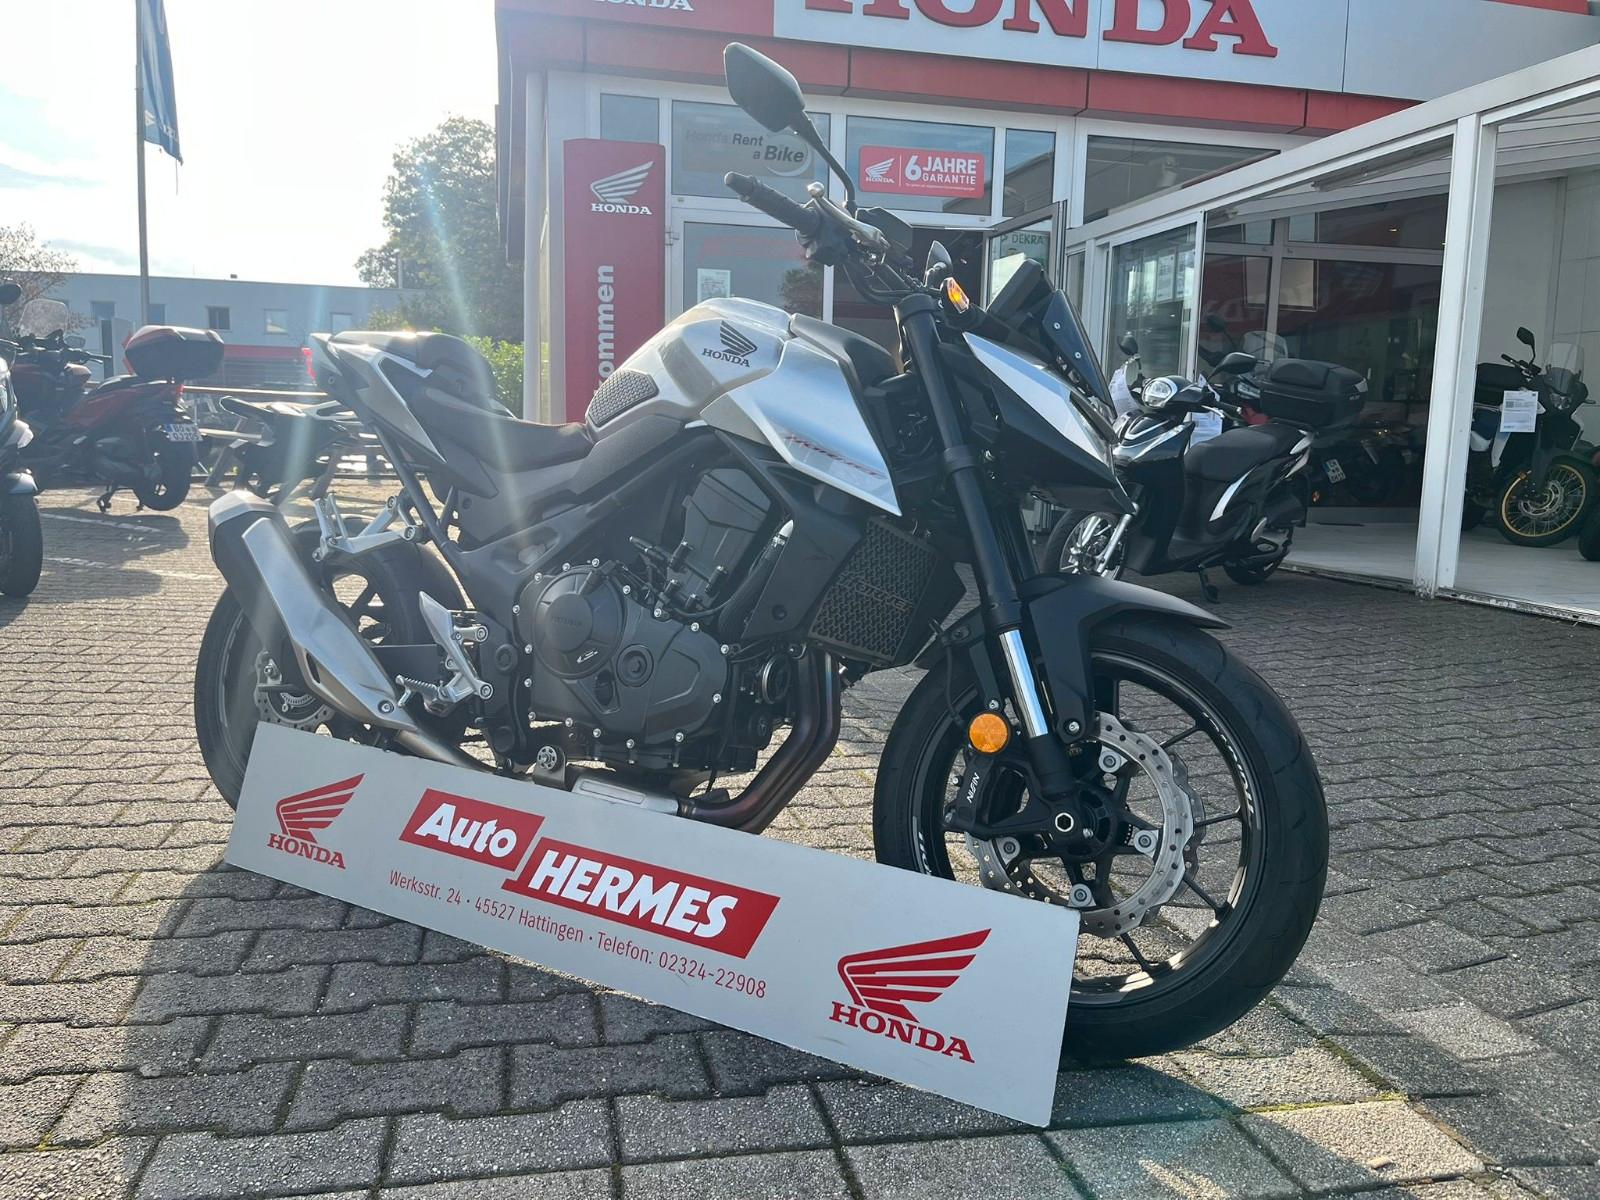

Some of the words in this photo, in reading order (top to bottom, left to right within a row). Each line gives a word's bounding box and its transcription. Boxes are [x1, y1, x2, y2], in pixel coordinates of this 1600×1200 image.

[804, 0, 1279, 57] NDA
[732, 133, 764, 147] Rent
[753, 150, 761, 160] a
[764, 145, 804, 162] Bike
[905, 155, 922, 181] 6
[922, 156, 977, 174] JAHRE
[922, 173, 977, 185] GARANTIE
[591, 203, 652, 215] HONDA
[1012, 234, 1044, 244] DEKRA
[594, 265, 614, 394] ommen
[702, 348, 750, 367] HONDA
[414, 803, 517, 858] Auto
[267, 833, 346, 869] HONDA
[528, 850, 739, 938] HERMES
[390, 870, 441, 900] Werksstr.
[447, 888, 461, 905] 24
[475, 897, 515, 920] 45527
[518, 909, 584, 943] Hattingen
[598, 932, 654, 964] Telefon:
[659, 952, 766, 998] 02324-22908
[830, 1002, 975, 1063] HONDA
